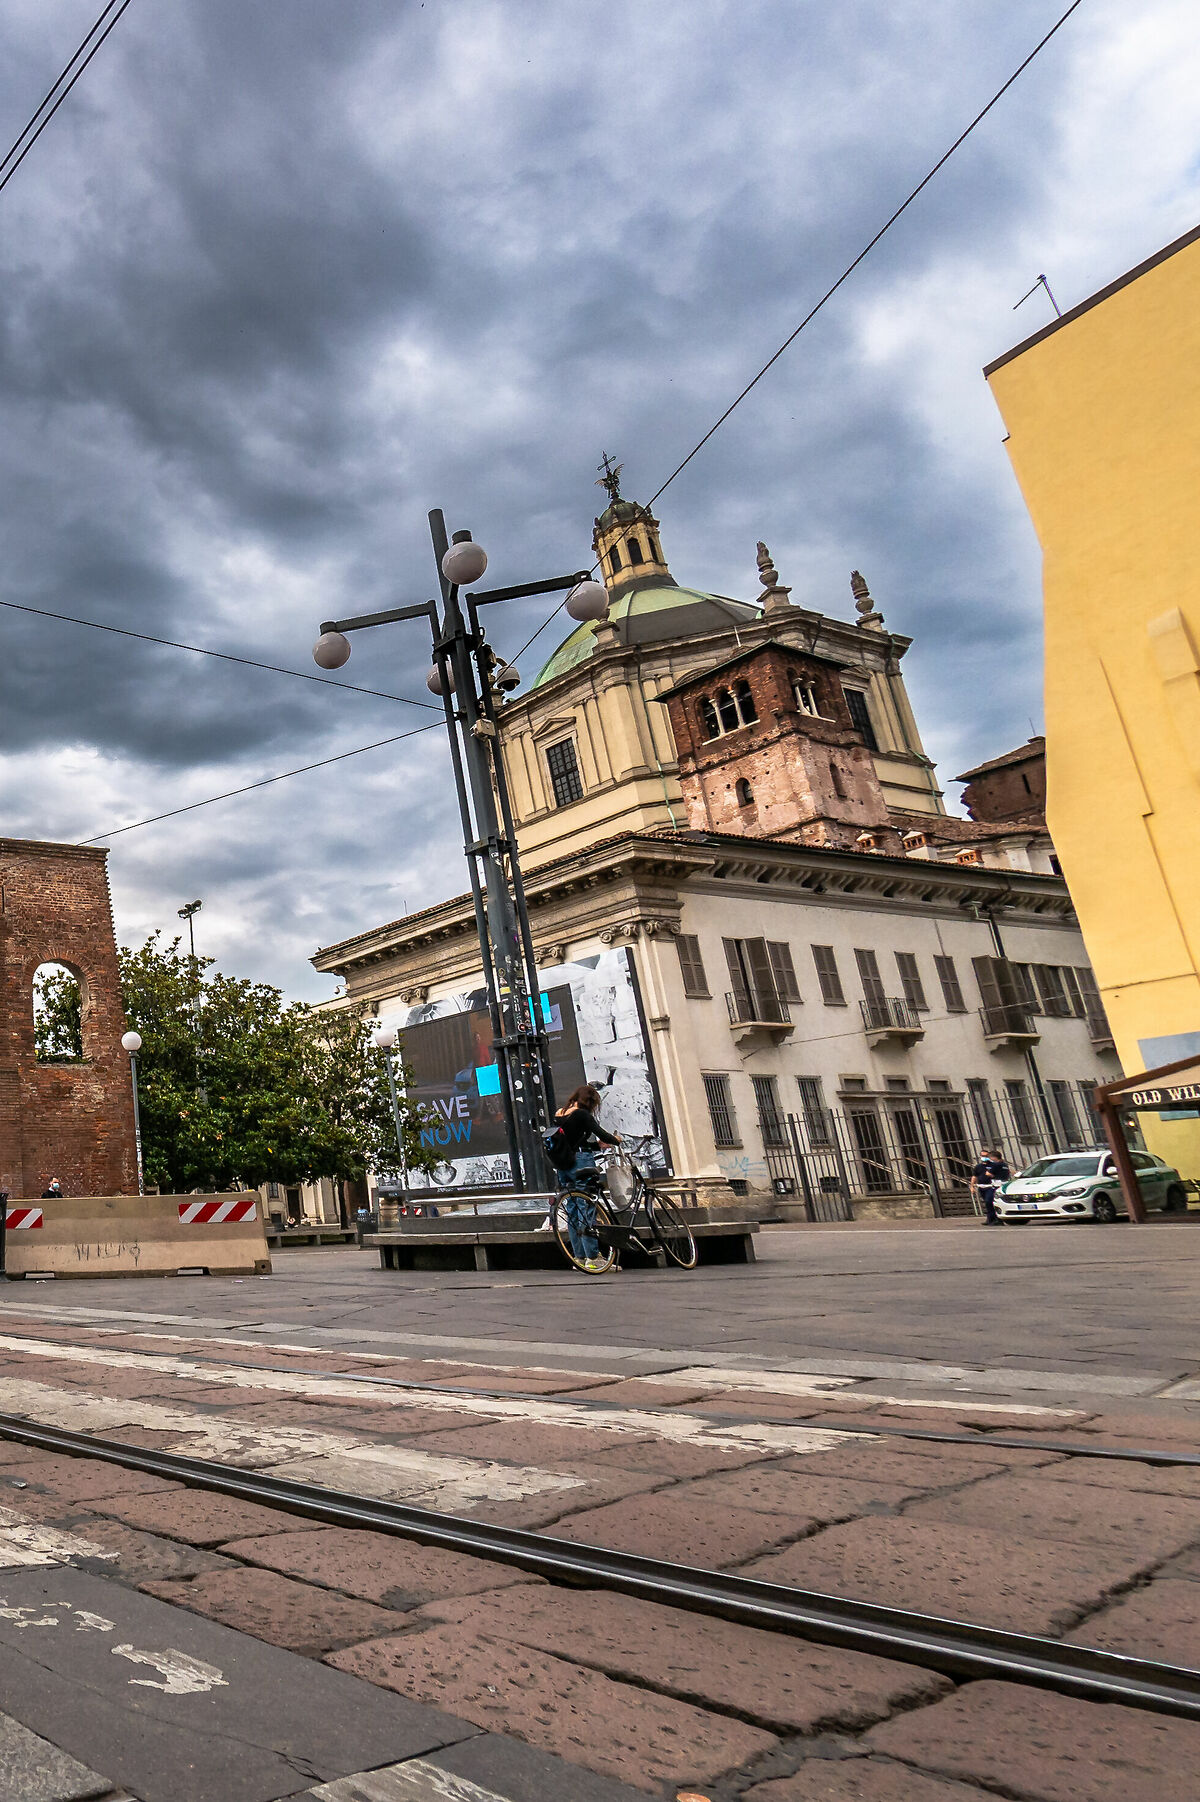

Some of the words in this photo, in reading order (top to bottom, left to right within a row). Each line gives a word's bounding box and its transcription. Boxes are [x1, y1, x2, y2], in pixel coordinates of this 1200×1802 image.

[416, 1094, 470, 1123] SAVE
[1132, 1090, 1162, 1106] OLD
[1165, 1085, 1200, 1100] WIL
[419, 1119, 473, 1148] NOW
